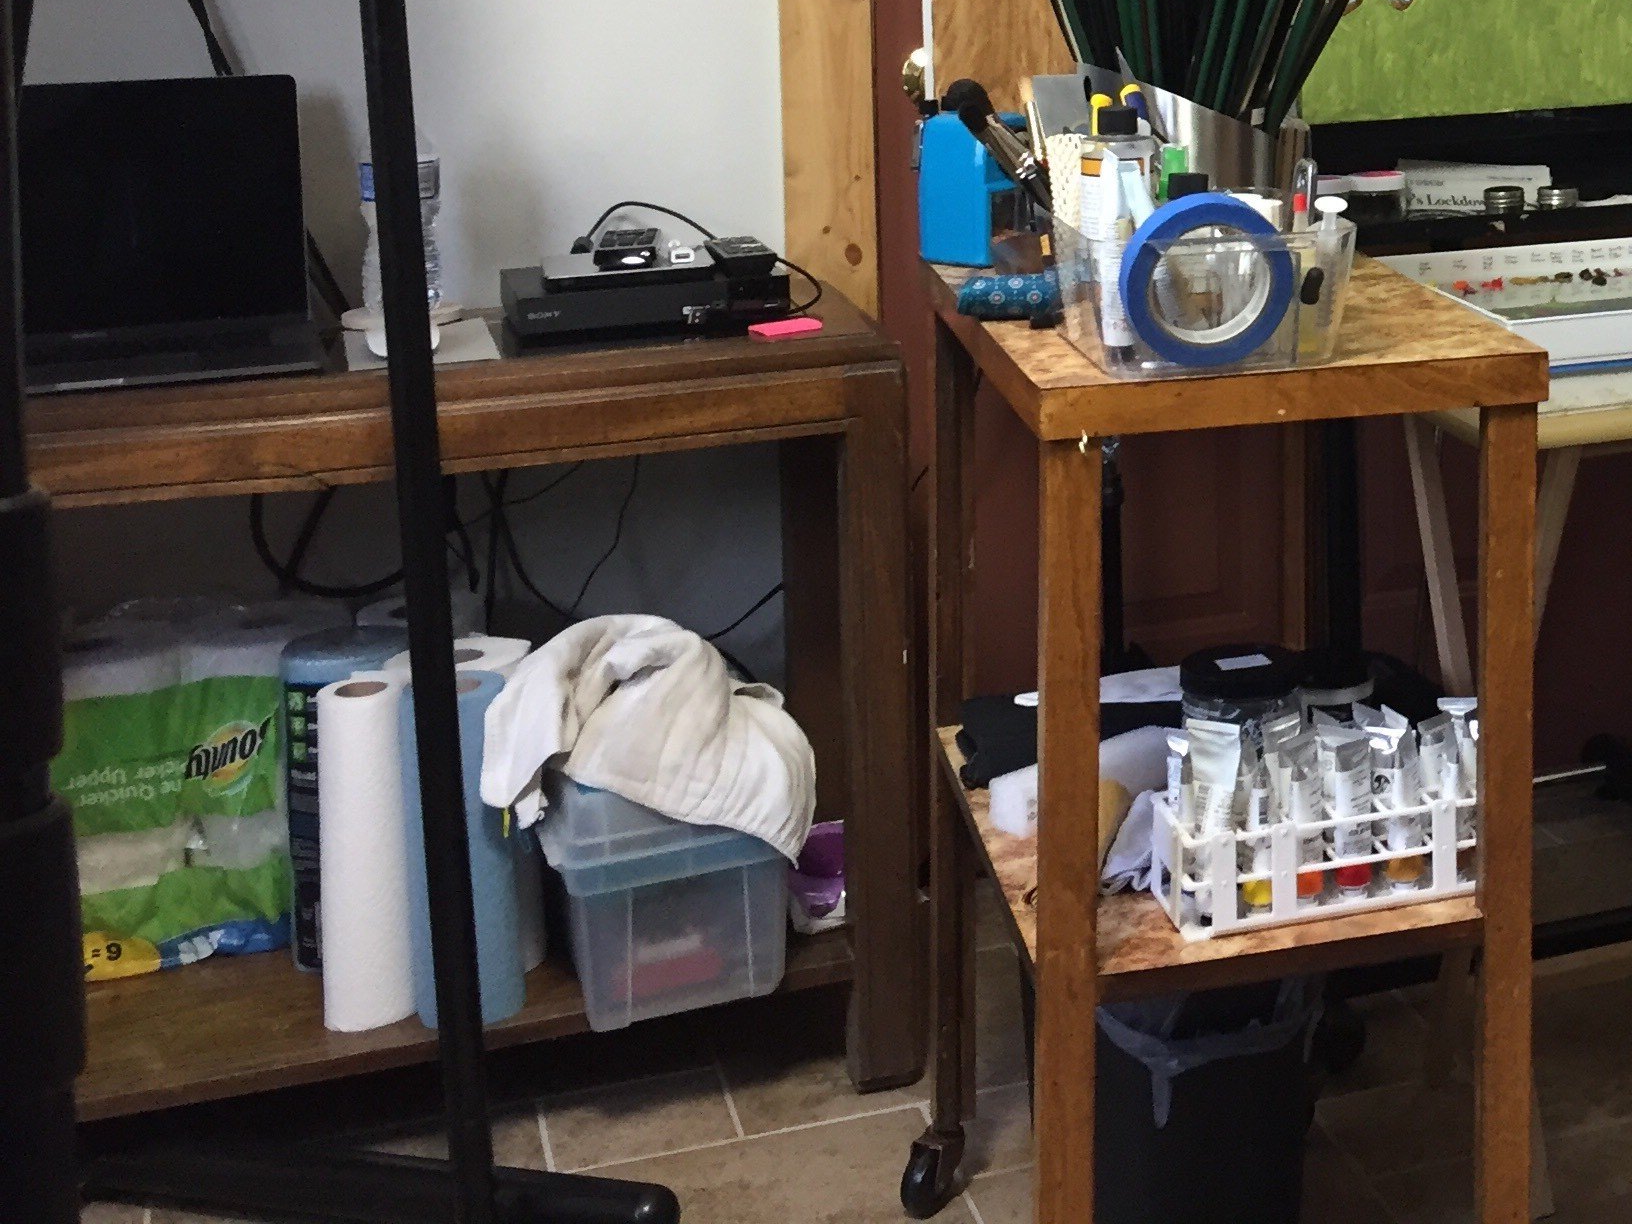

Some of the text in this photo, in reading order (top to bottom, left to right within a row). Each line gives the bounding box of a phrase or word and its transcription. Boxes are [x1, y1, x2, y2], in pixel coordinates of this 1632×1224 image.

[1426, 193, 1485, 206] Lockdow
[62, 766, 127, 790] Upper
[79, 783, 155, 807] Quicker
